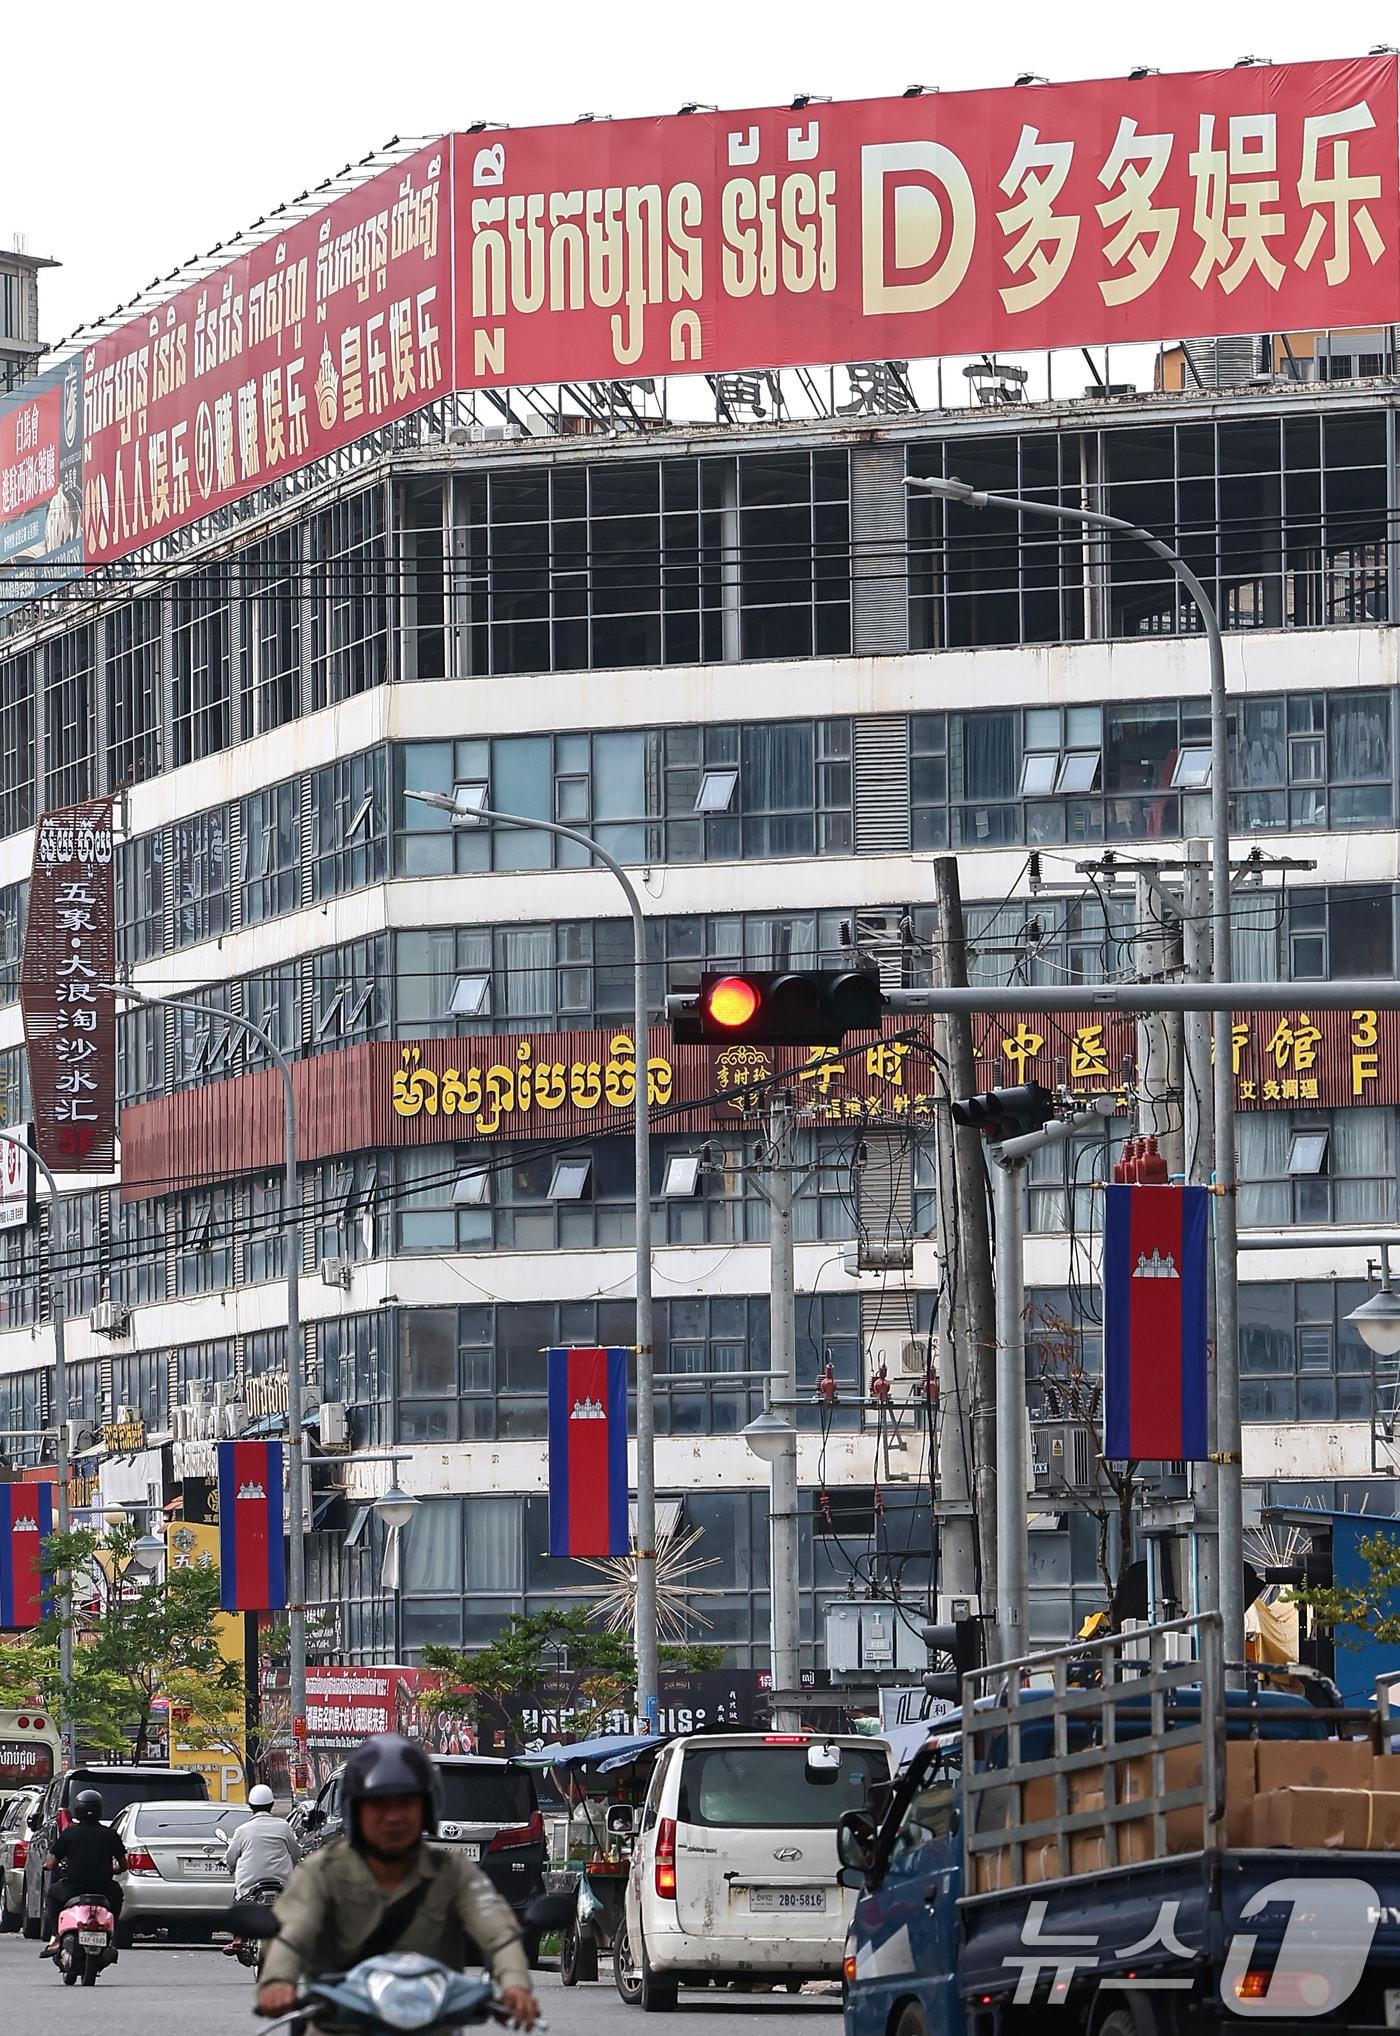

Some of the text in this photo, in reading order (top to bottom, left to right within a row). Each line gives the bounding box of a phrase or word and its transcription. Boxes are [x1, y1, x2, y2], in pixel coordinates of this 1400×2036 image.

[861, 100, 1386, 316] D 多多娱乐
[340, 286, 442, 422] 皇乐娱乐
[113, 420, 191, 544] 人人娱乐
[716, 1065, 772, 1088] 李时珍
[1351, 1010, 1379, 1095] 3F
[59, 1127, 97, 1154] 5F
